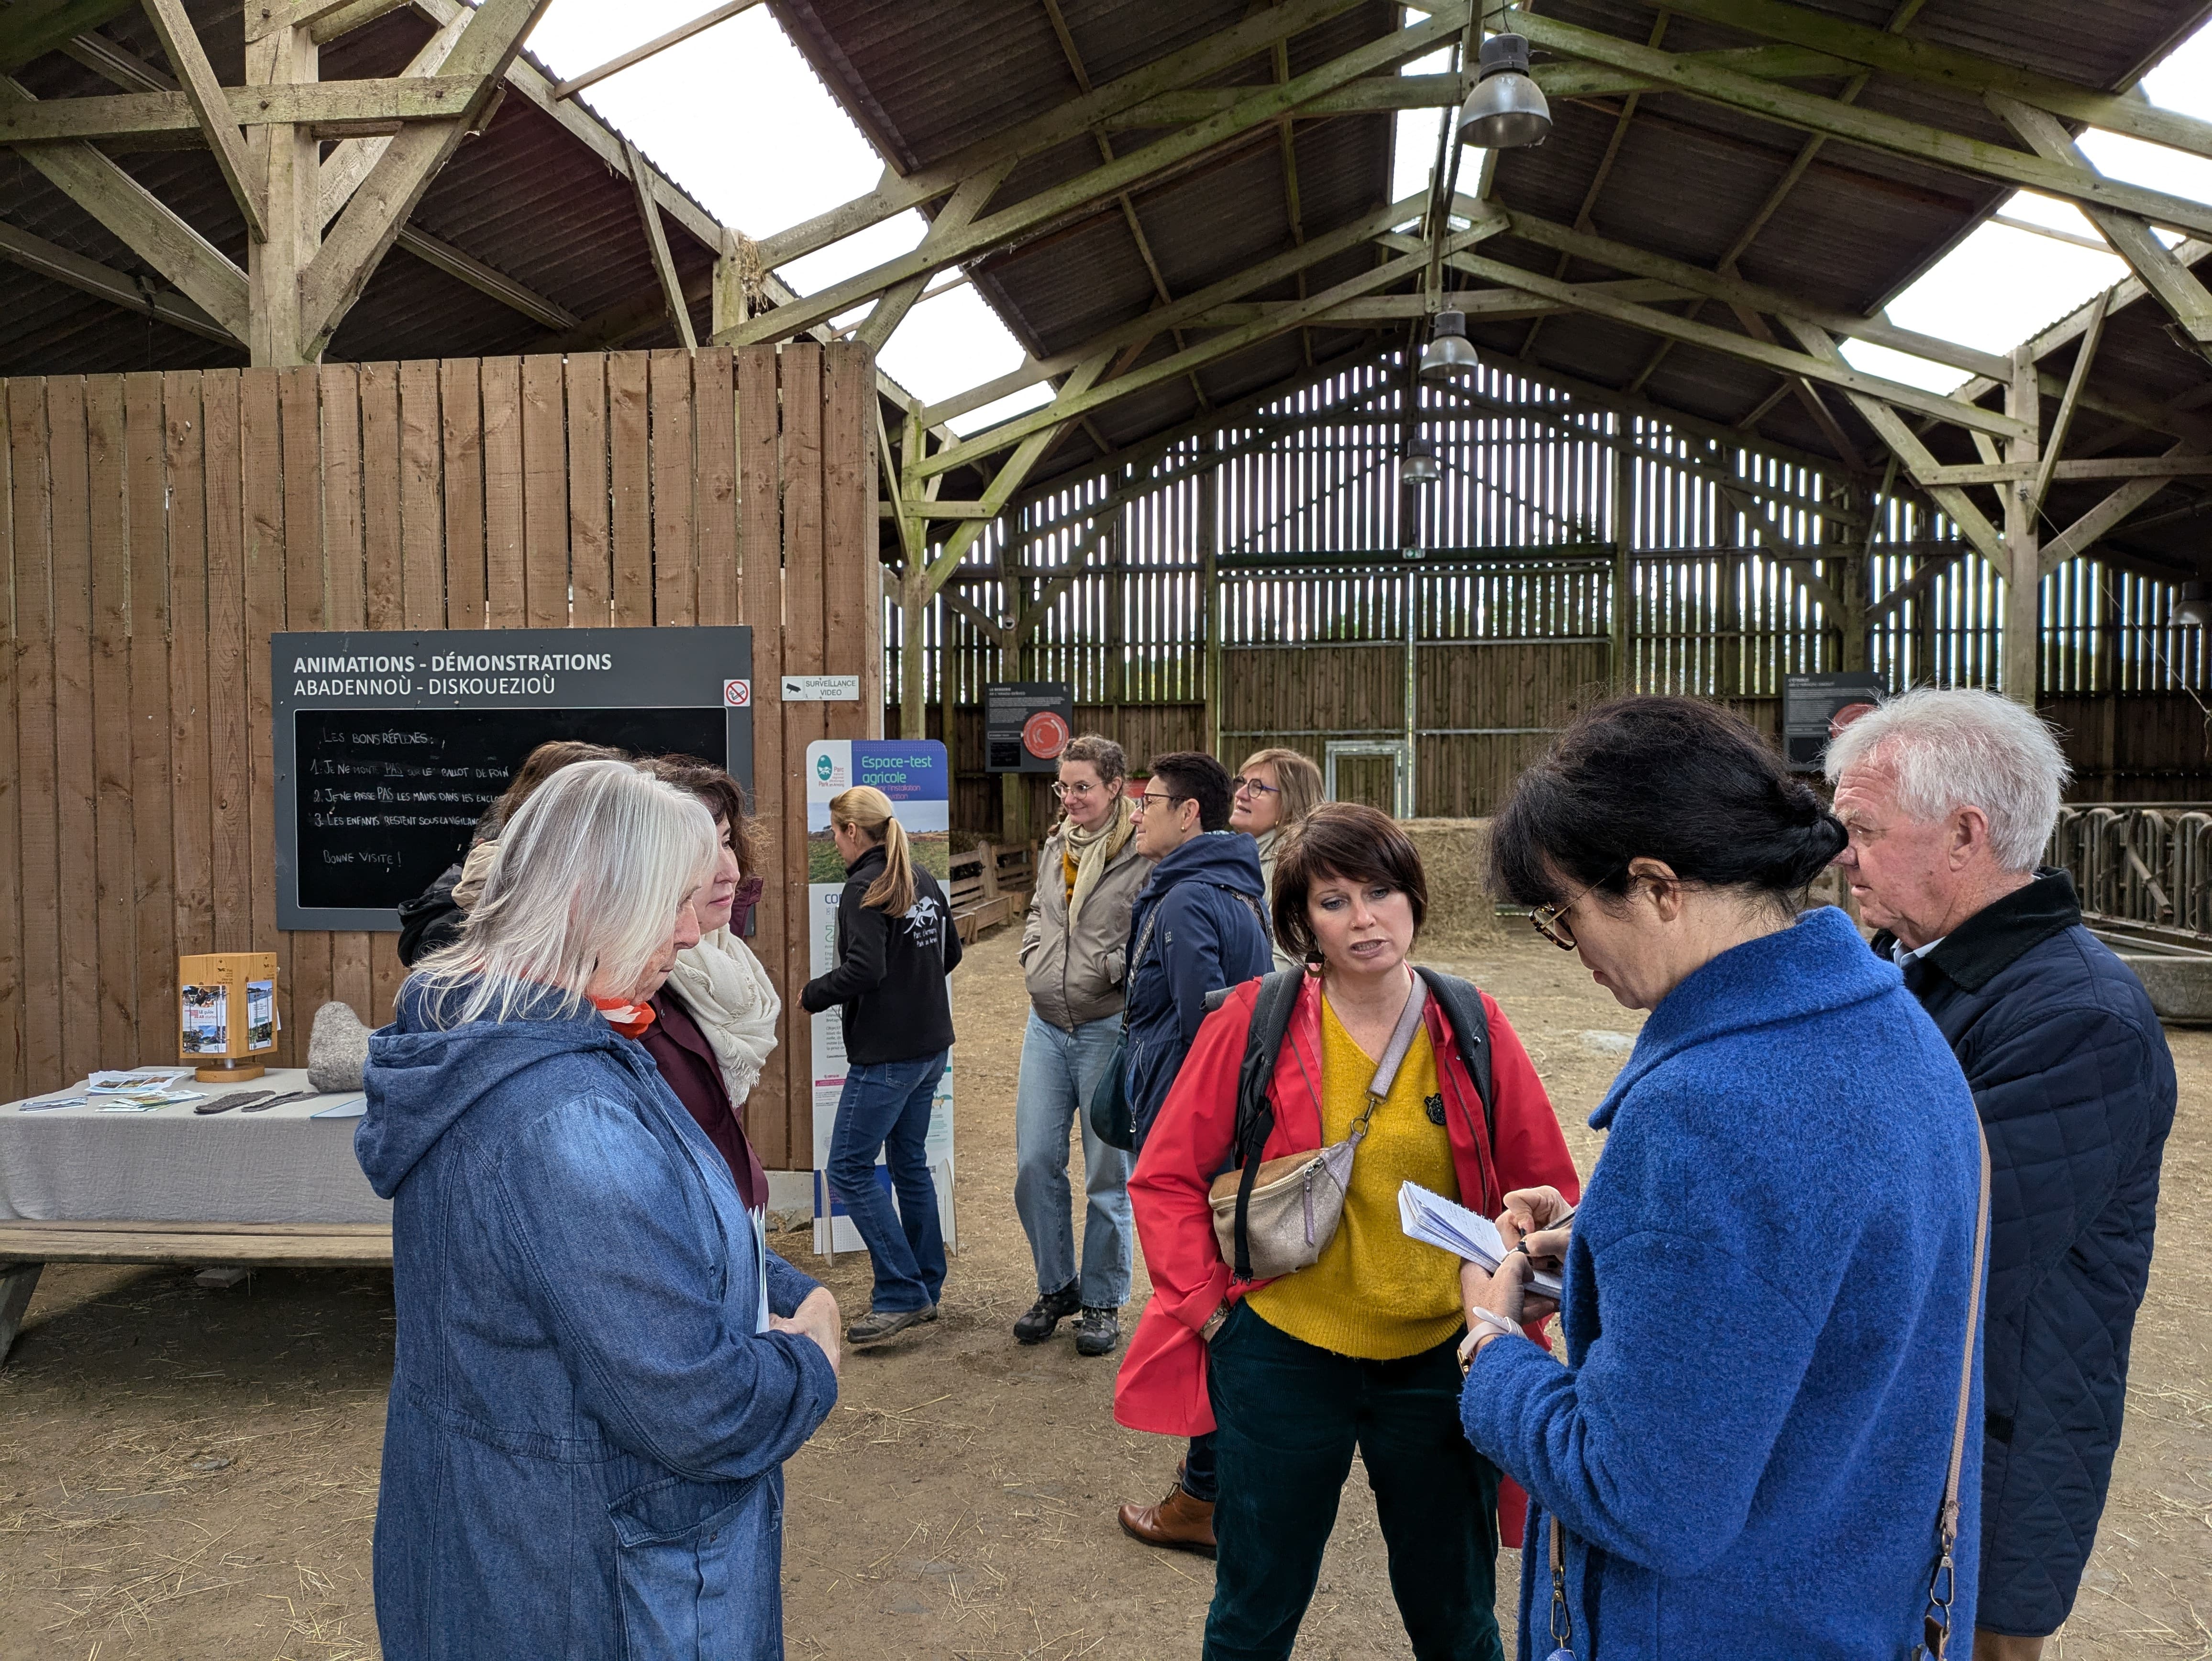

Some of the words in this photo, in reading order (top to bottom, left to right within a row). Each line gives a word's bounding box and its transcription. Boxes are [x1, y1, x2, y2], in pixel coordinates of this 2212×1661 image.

[293, 655, 415, 673] ANIMATIONS
[431, 651, 612, 672] DÉMONSTRATIONS
[293, 675, 411, 696] ABADENNOÙ
[429, 673, 555, 695] DISKOUEZIOÙ
[323, 727, 344, 742] LES
[352, 733, 380, 745] BONS
[338, 764, 350, 775] NE
[384, 762, 403, 775] PAS
[422, 768, 433, 776] LE
[476, 769, 487, 778] DE
[862, 755, 932, 770] Espace-test
[862, 771, 907, 786] agricole
[313, 789, 323, 802] 2.
[354, 792, 376, 801] PASSE
[377, 786, 393, 801] PAS
[397, 793, 410, 801] LES
[413, 792, 436, 802] MAINS
[439, 792, 459, 802] DANS
[462, 794, 474, 803] LES
[315, 813, 324, 827] 3.
[327, 813, 344, 826] LES
[347, 816, 380, 826] ENFANTS
[384, 816, 417, 826] RESTENT
[419, 816, 439, 825] SOUS
[440, 817, 448, 825] LA
[323, 850, 354, 864] BONNE
[359, 852, 394, 864] VISITE
